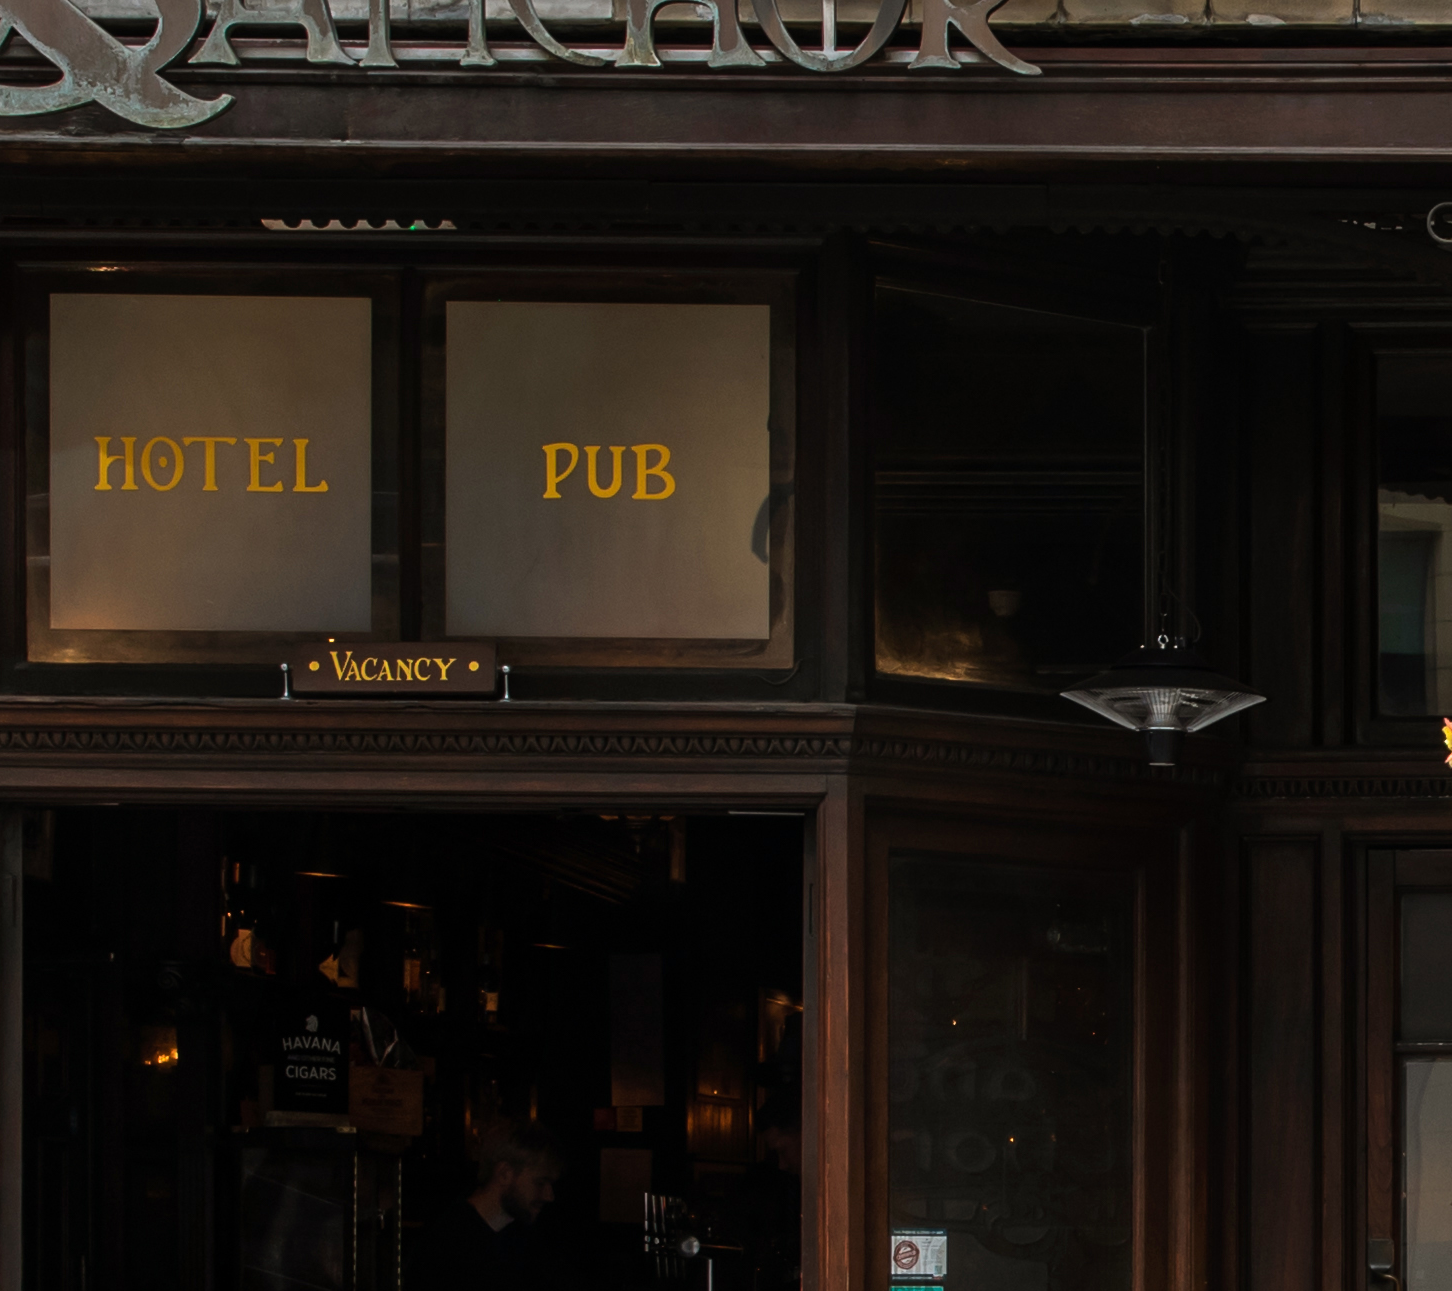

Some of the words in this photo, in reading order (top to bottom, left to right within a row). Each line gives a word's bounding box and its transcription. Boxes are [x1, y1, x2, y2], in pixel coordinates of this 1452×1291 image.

[93, 436, 330, 493] HOTEL
[542, 443, 677, 501] PUB
[328, 651, 458, 683] VACANCY
[281, 1034, 342, 1055] HAVANA
[284, 1064, 338, 1081] CIGARS
